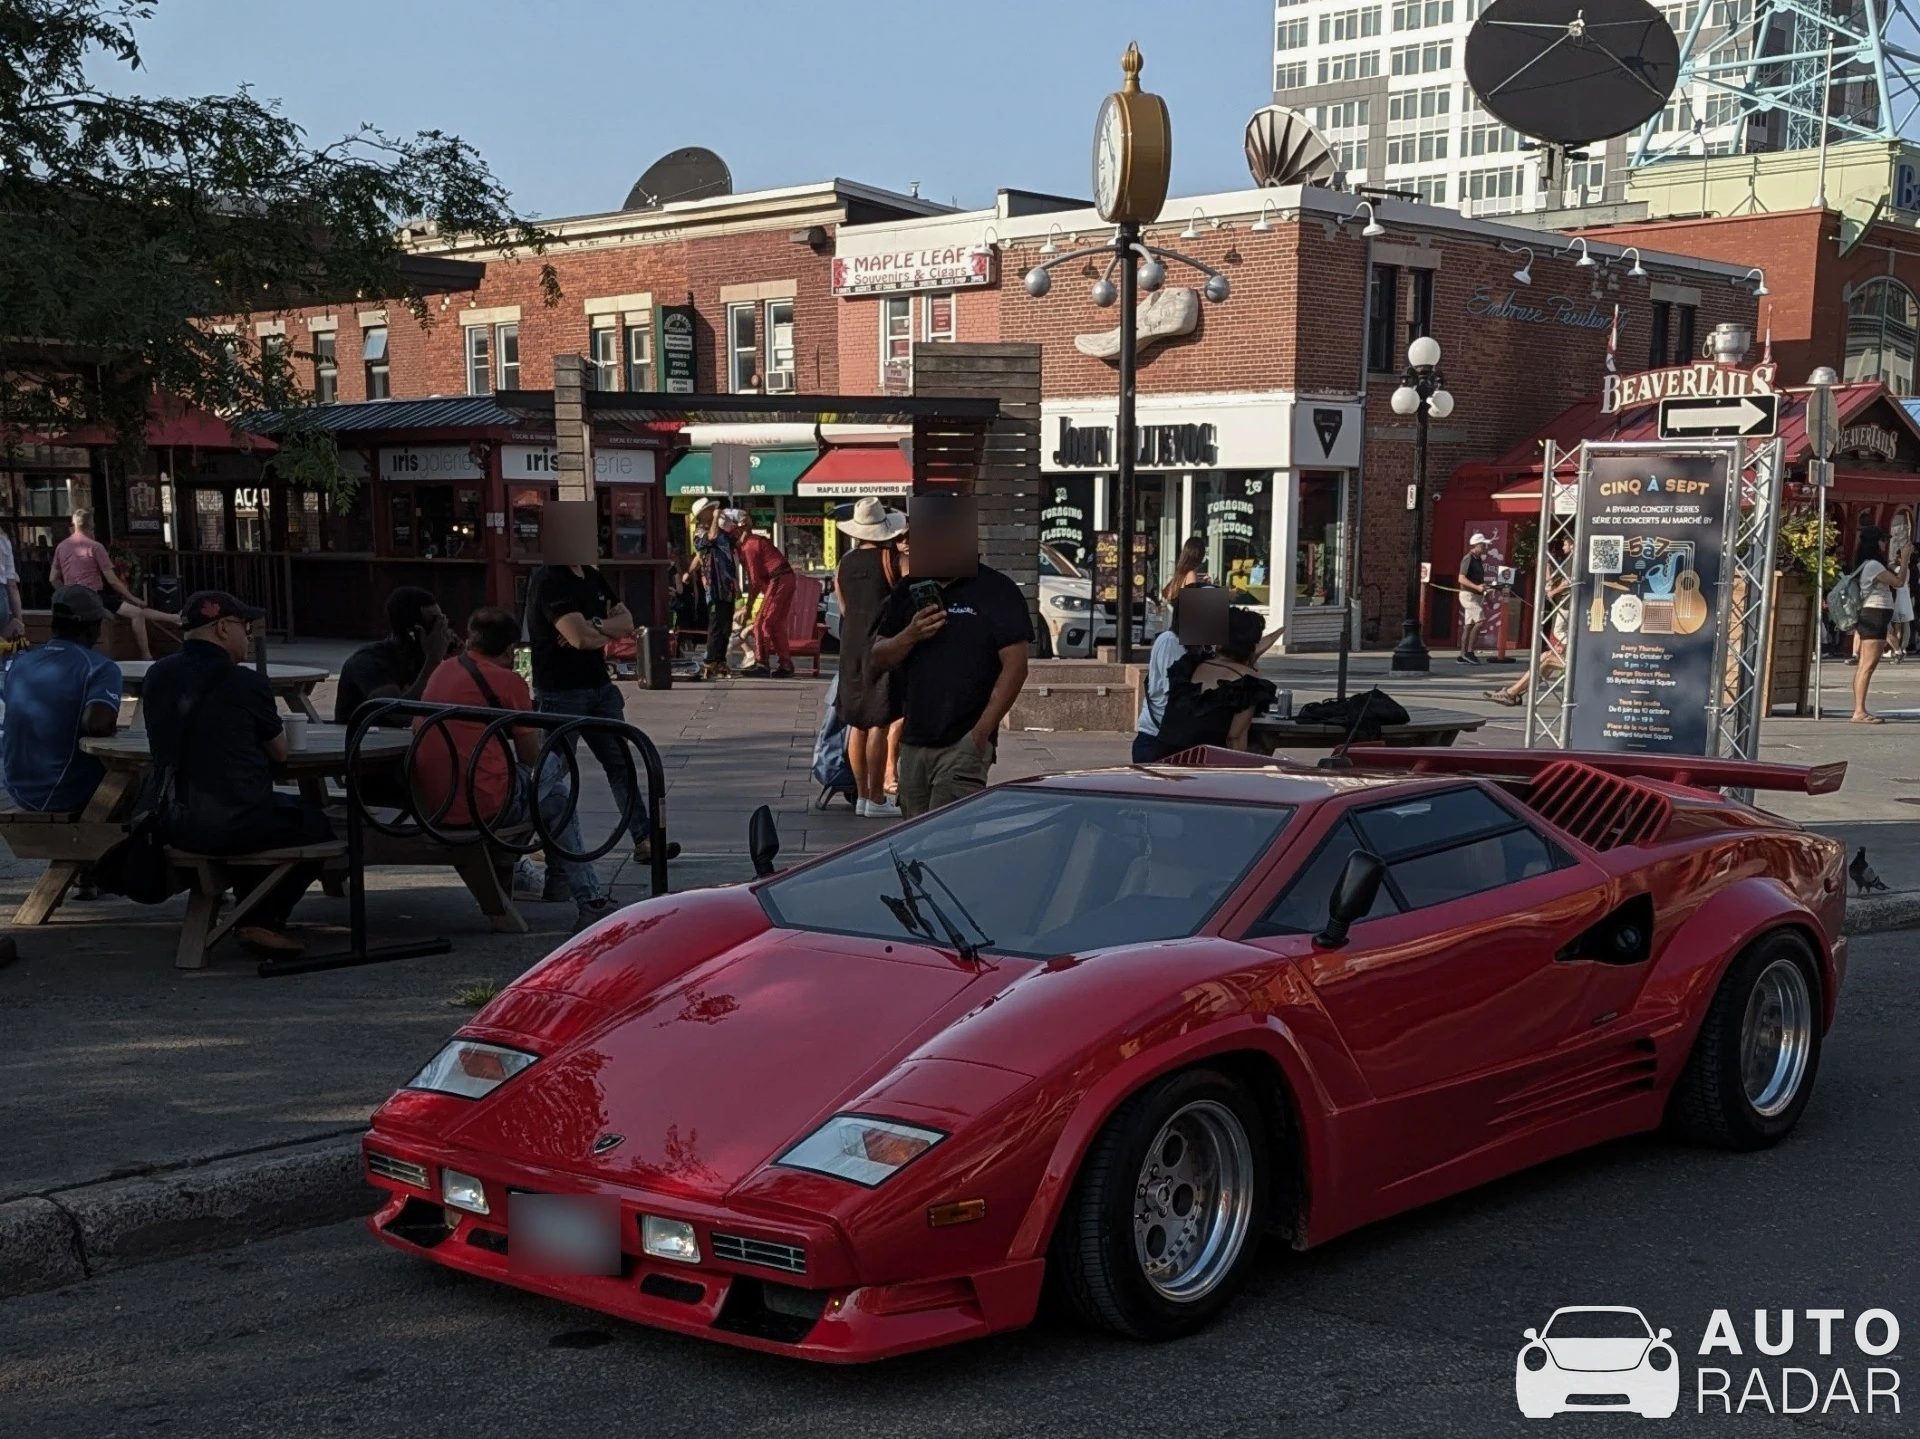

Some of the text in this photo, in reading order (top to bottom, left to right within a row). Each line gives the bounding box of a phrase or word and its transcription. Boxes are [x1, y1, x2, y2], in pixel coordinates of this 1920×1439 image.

[854, 247, 966, 273] MAPLE LEAF
[854, 267, 967, 285] Souvenirs & Cigars
[1466, 286, 1631, 336] Embrace Peculiarty
[1600, 363, 1776, 414] BEAVERTAILS
[1053, 415, 1219, 468] JOHN LUEVOG
[1836, 425, 1899, 460] BEAVERTAILS
[817, 486, 839, 494] MAPLE
[842, 486, 857, 494] LEAF
[859, 485, 900, 494] SOUVENIRS
[1600, 475, 1710, 497] CINQ À SEPT
[1041, 506, 1083, 521] FORAGING
[1207, 499, 1254, 515] FORAGING
[1605, 505, 1700, 514] A BYWARD CONCERT SERIES
[1055, 518, 1068, 526] FOR
[1223, 512, 1237, 521] FOR
[1592, 516, 1713, 525] SÉRIE DE CONCERTS AU MARCHÉ BY
[1620, 645, 1665, 654] Every Thursday
[1656, 679, 1676, 687] Square
